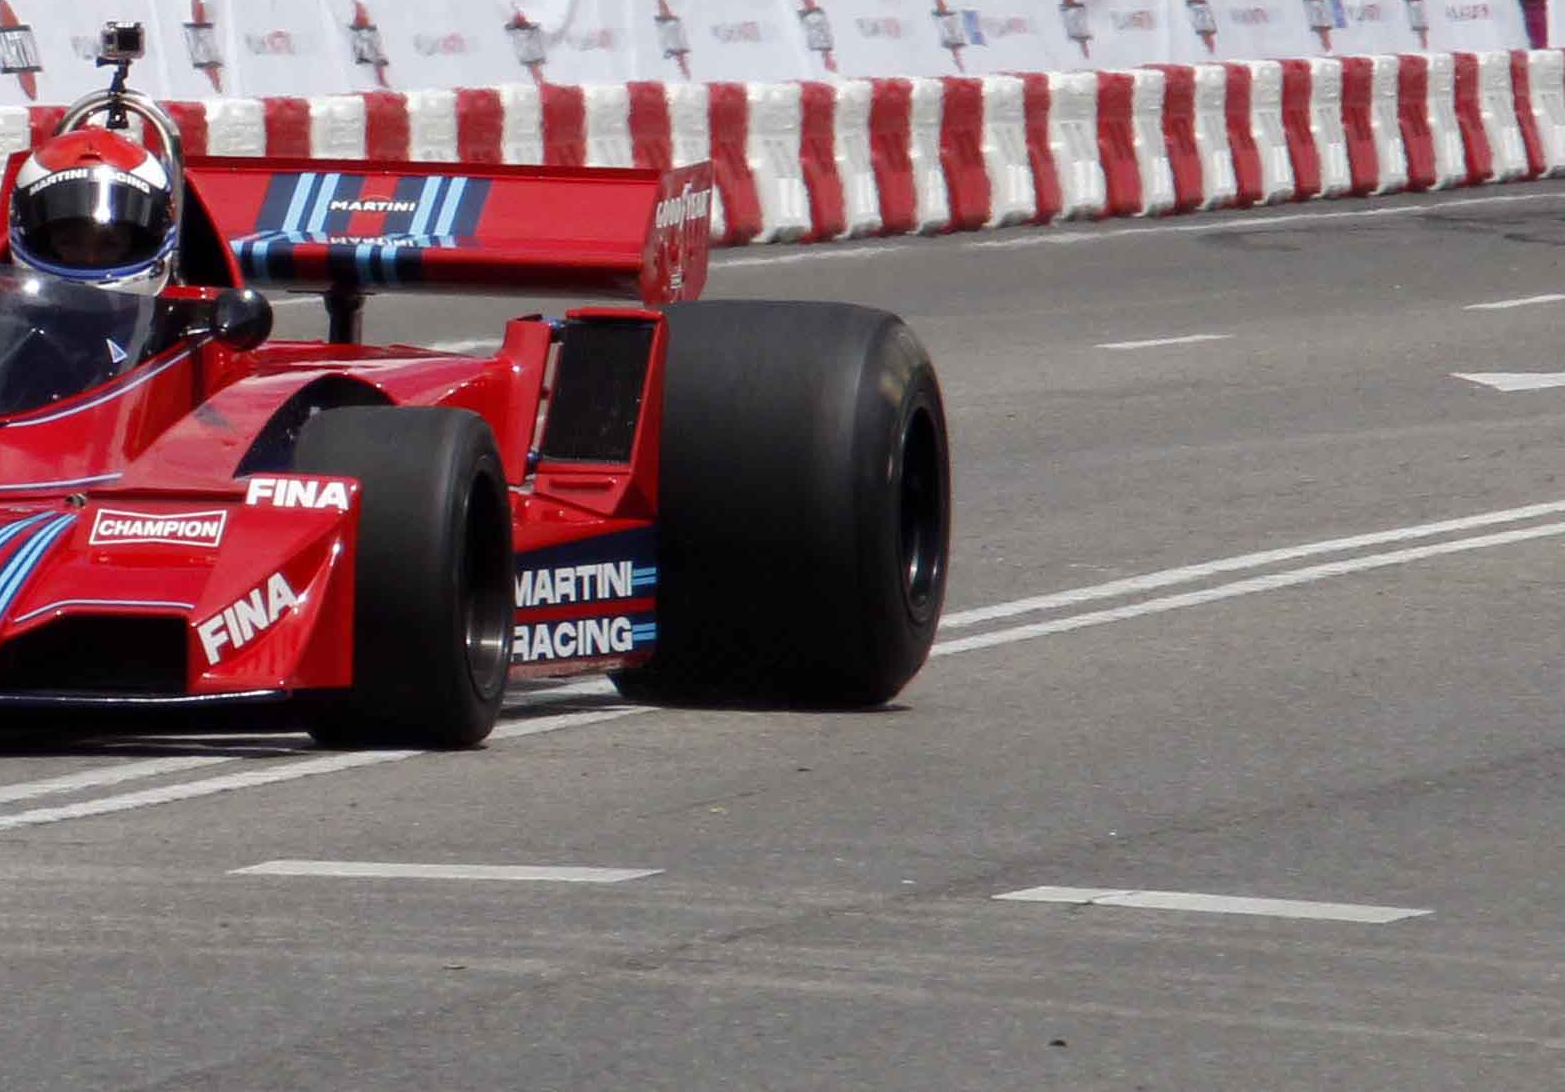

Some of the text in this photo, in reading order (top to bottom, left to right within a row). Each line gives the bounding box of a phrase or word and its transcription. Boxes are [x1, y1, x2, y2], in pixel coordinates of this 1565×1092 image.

[29, 167, 89, 196] MARTINI
[330, 200, 416, 212] MARTINI
[245, 478, 349, 510] FINA
[97, 519, 218, 538] CHAMPION
[515, 560, 633, 607] MARTINI
[197, 572, 298, 665] FINA
[510, 616, 633, 662] RACING
